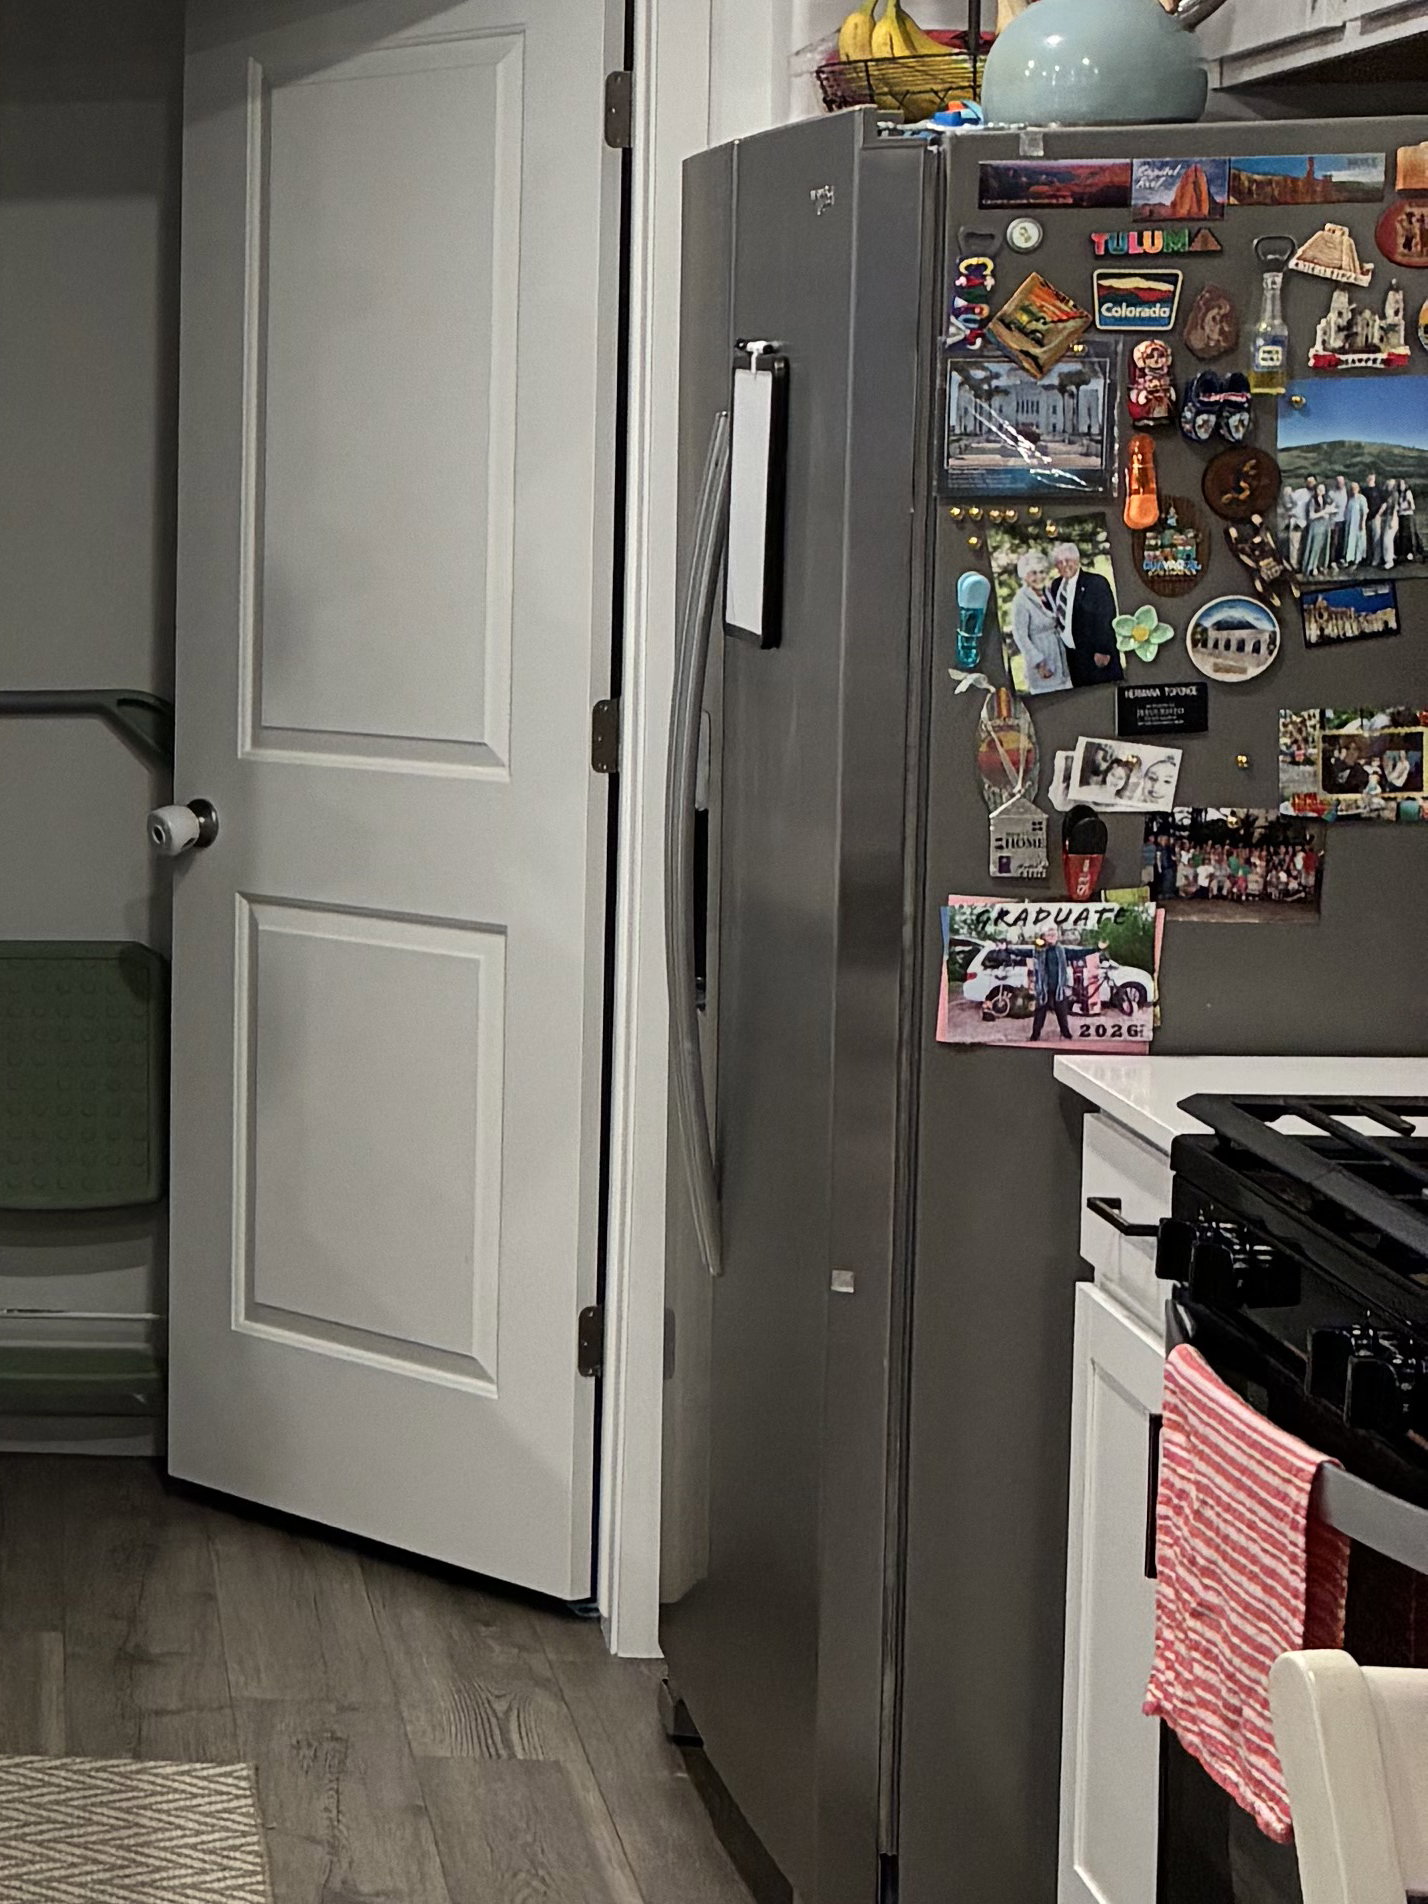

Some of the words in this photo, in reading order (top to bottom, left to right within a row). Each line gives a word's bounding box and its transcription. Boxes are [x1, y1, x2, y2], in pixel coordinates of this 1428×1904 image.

[1090, 228, 1188, 256] TULUM
[1101, 301, 1170, 319] Colorado
[1005, 837, 1044, 849] HOME
[975, 906, 1127, 931] GRADUATE
[1079, 1023, 1138, 1039] 2026
